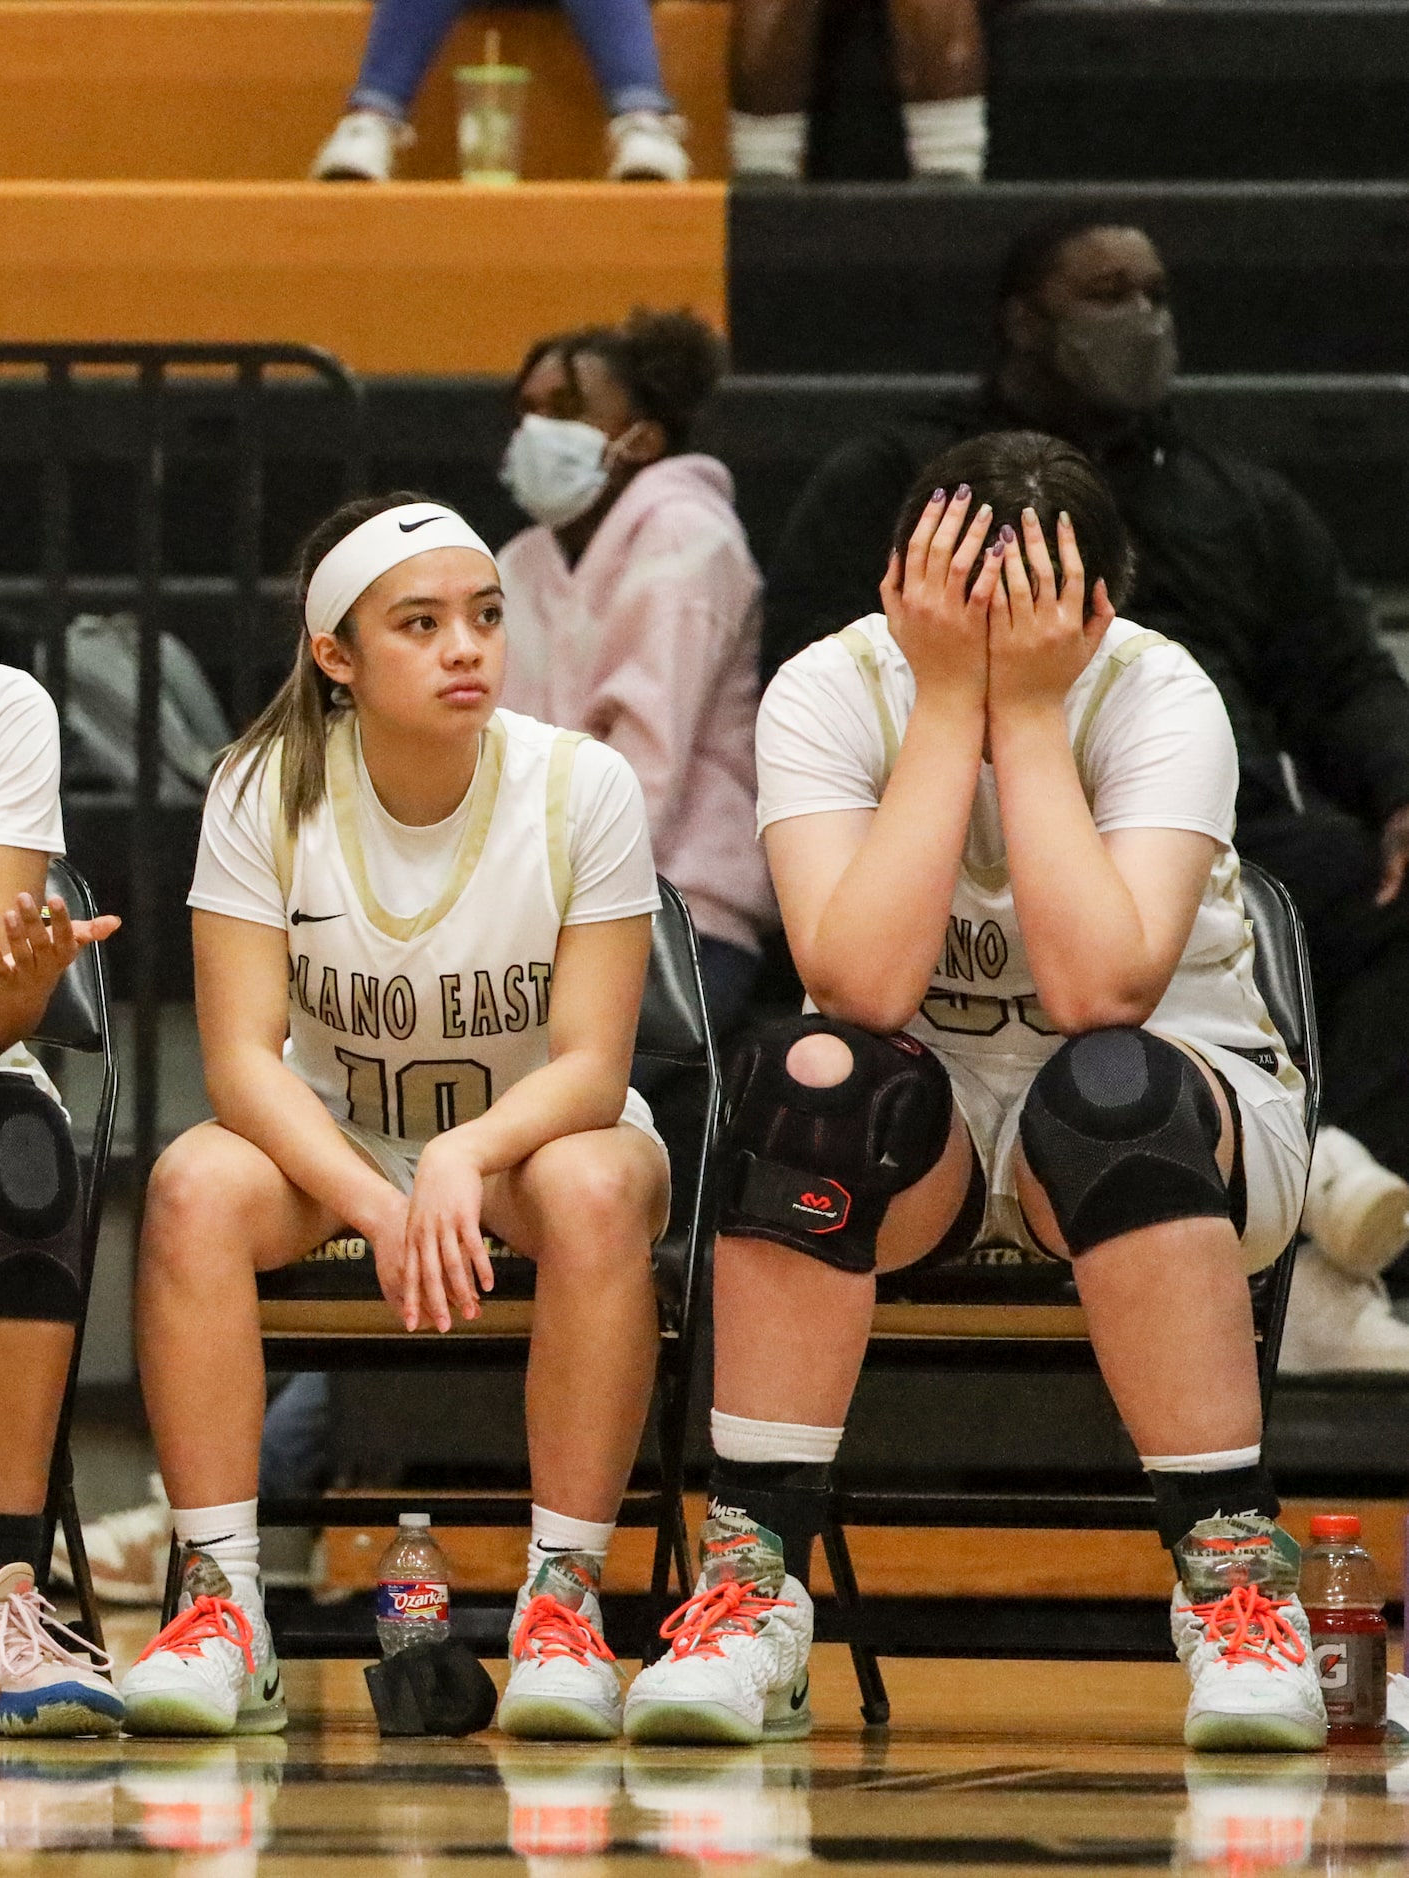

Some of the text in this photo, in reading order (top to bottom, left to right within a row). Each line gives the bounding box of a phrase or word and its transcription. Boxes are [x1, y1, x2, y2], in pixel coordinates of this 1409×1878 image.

[935, 914, 1009, 982] NO
[440, 962, 552, 1038] EAST
[334, 1045, 492, 1138] 10
[1258, 1054, 1274, 1064] XXL
[1312, 1643, 1349, 1690] G
